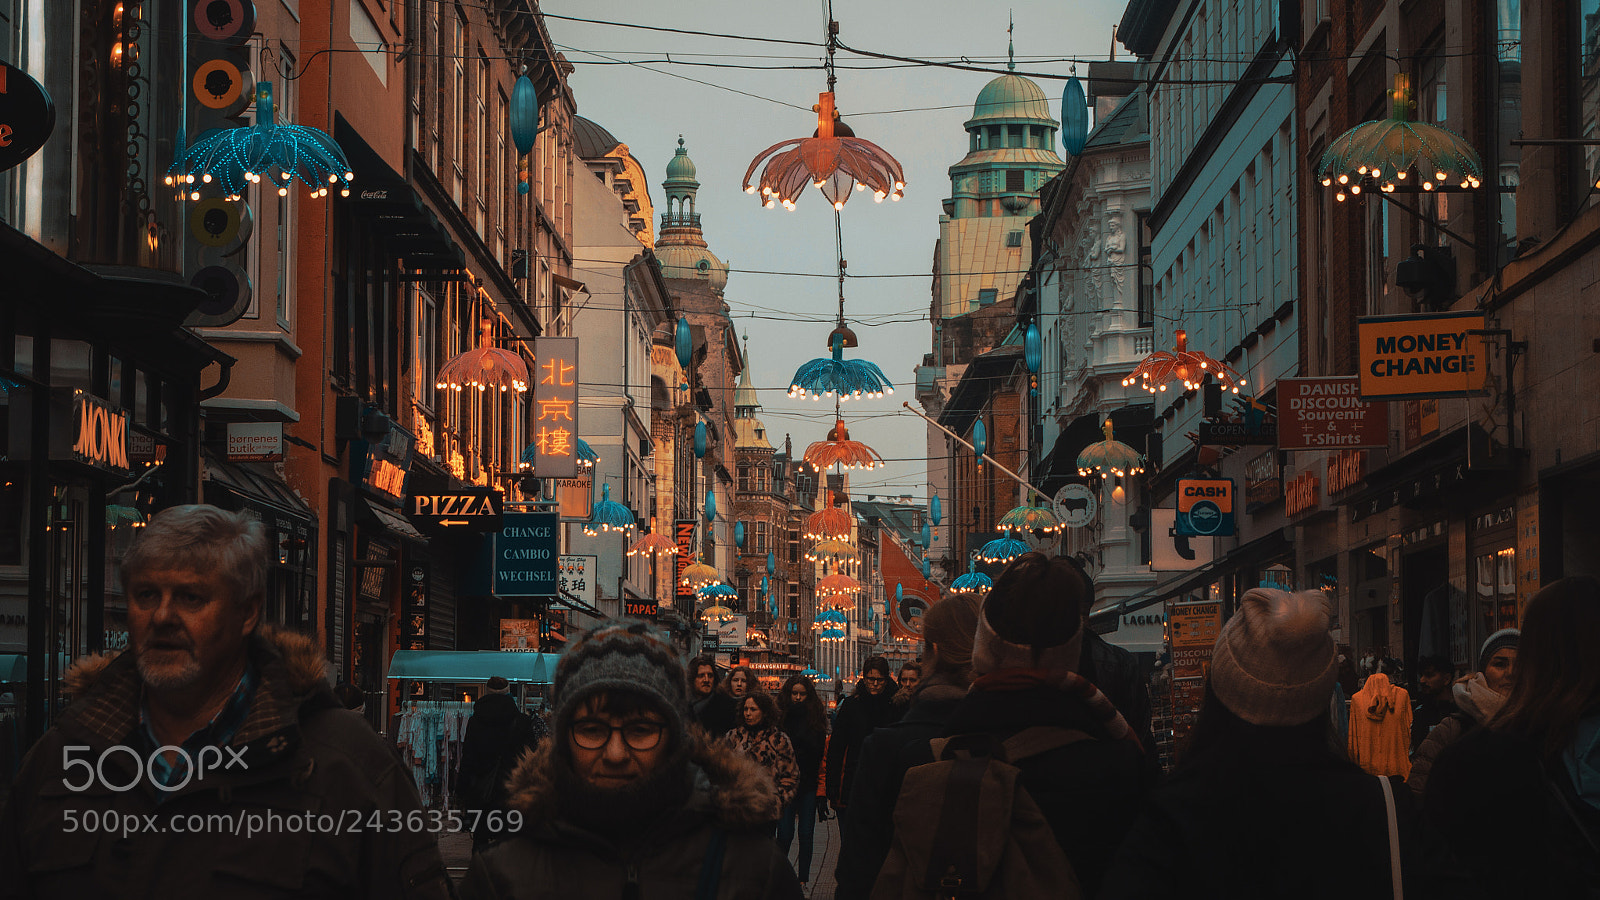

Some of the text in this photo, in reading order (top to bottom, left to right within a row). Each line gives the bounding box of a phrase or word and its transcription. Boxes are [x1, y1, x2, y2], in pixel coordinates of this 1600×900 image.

[1376, 333, 1467, 354] MONEY
[1370, 355, 1476, 377] CHANGE
[536, 358, 575, 456] 北京樓
[1290, 397, 1371, 410] DISCOUN
[1298, 408, 1366, 421] Souvenir
[1327, 421, 1337, 431] &
[229, 434, 278, 443] børnenes
[1302, 433, 1361, 445] T-Shirts
[229, 443, 255, 453] butik
[556, 480, 592, 489] KARAOKE
[1184, 487, 1226, 497] CASH
[413, 495, 497, 516] PIZZA
[503, 527, 551, 537] CHANGE
[503, 548, 550, 559] CAMBIO
[499, 571, 555, 581] WECHSEL
[627, 603, 657, 615] TAPAS
[1171, 605, 1218, 616] MONEY CHANGE
[1173, 648, 1214, 658] DISCOUN
